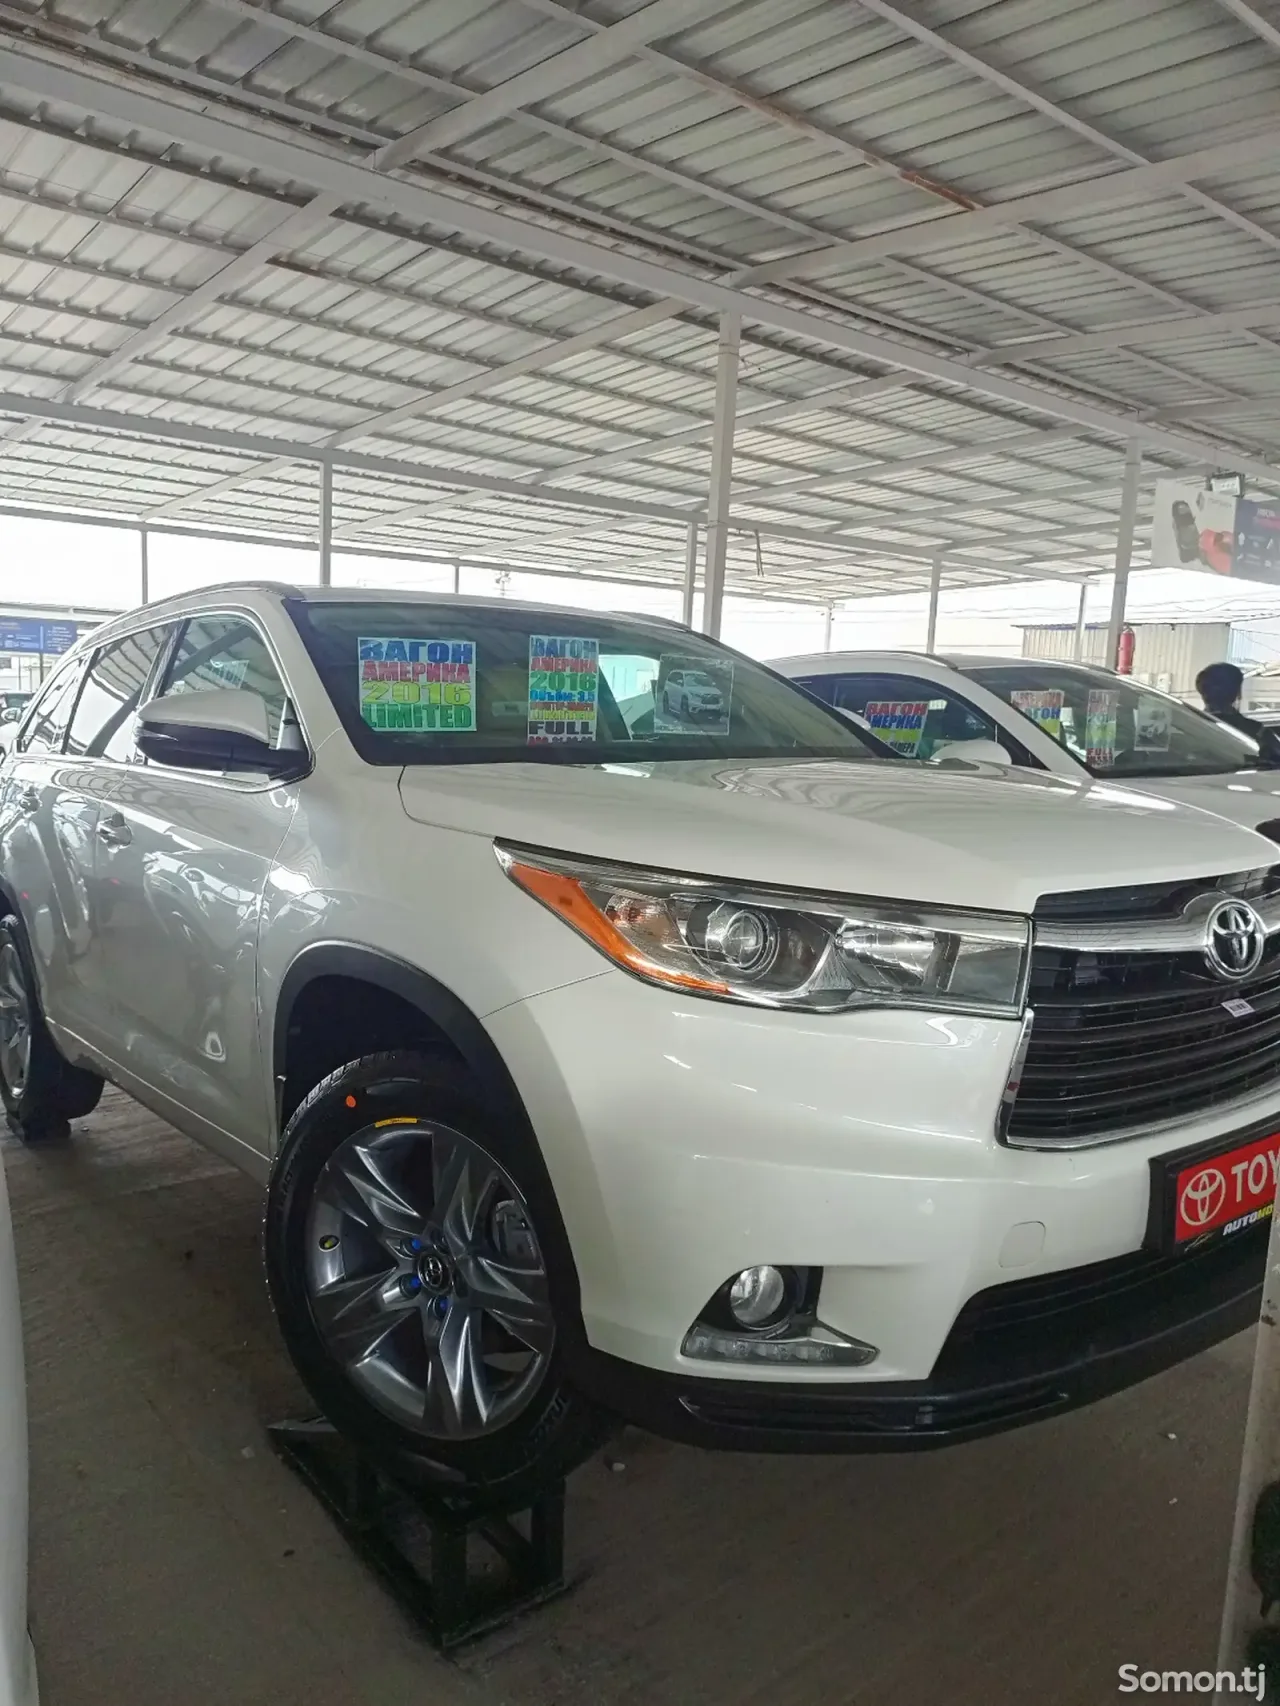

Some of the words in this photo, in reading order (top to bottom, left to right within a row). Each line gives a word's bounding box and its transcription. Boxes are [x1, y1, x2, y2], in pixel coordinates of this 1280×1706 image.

[359, 640, 473, 664] ВАГОН
[531, 637, 597, 659] ВАГОН
[362, 661, 471, 683] АМЕРИКА
[530, 670, 597, 691] 2016
[362, 681, 472, 705] 2016
[362, 703, 472, 729] LIMITED
[529, 721, 594, 735] FULL
